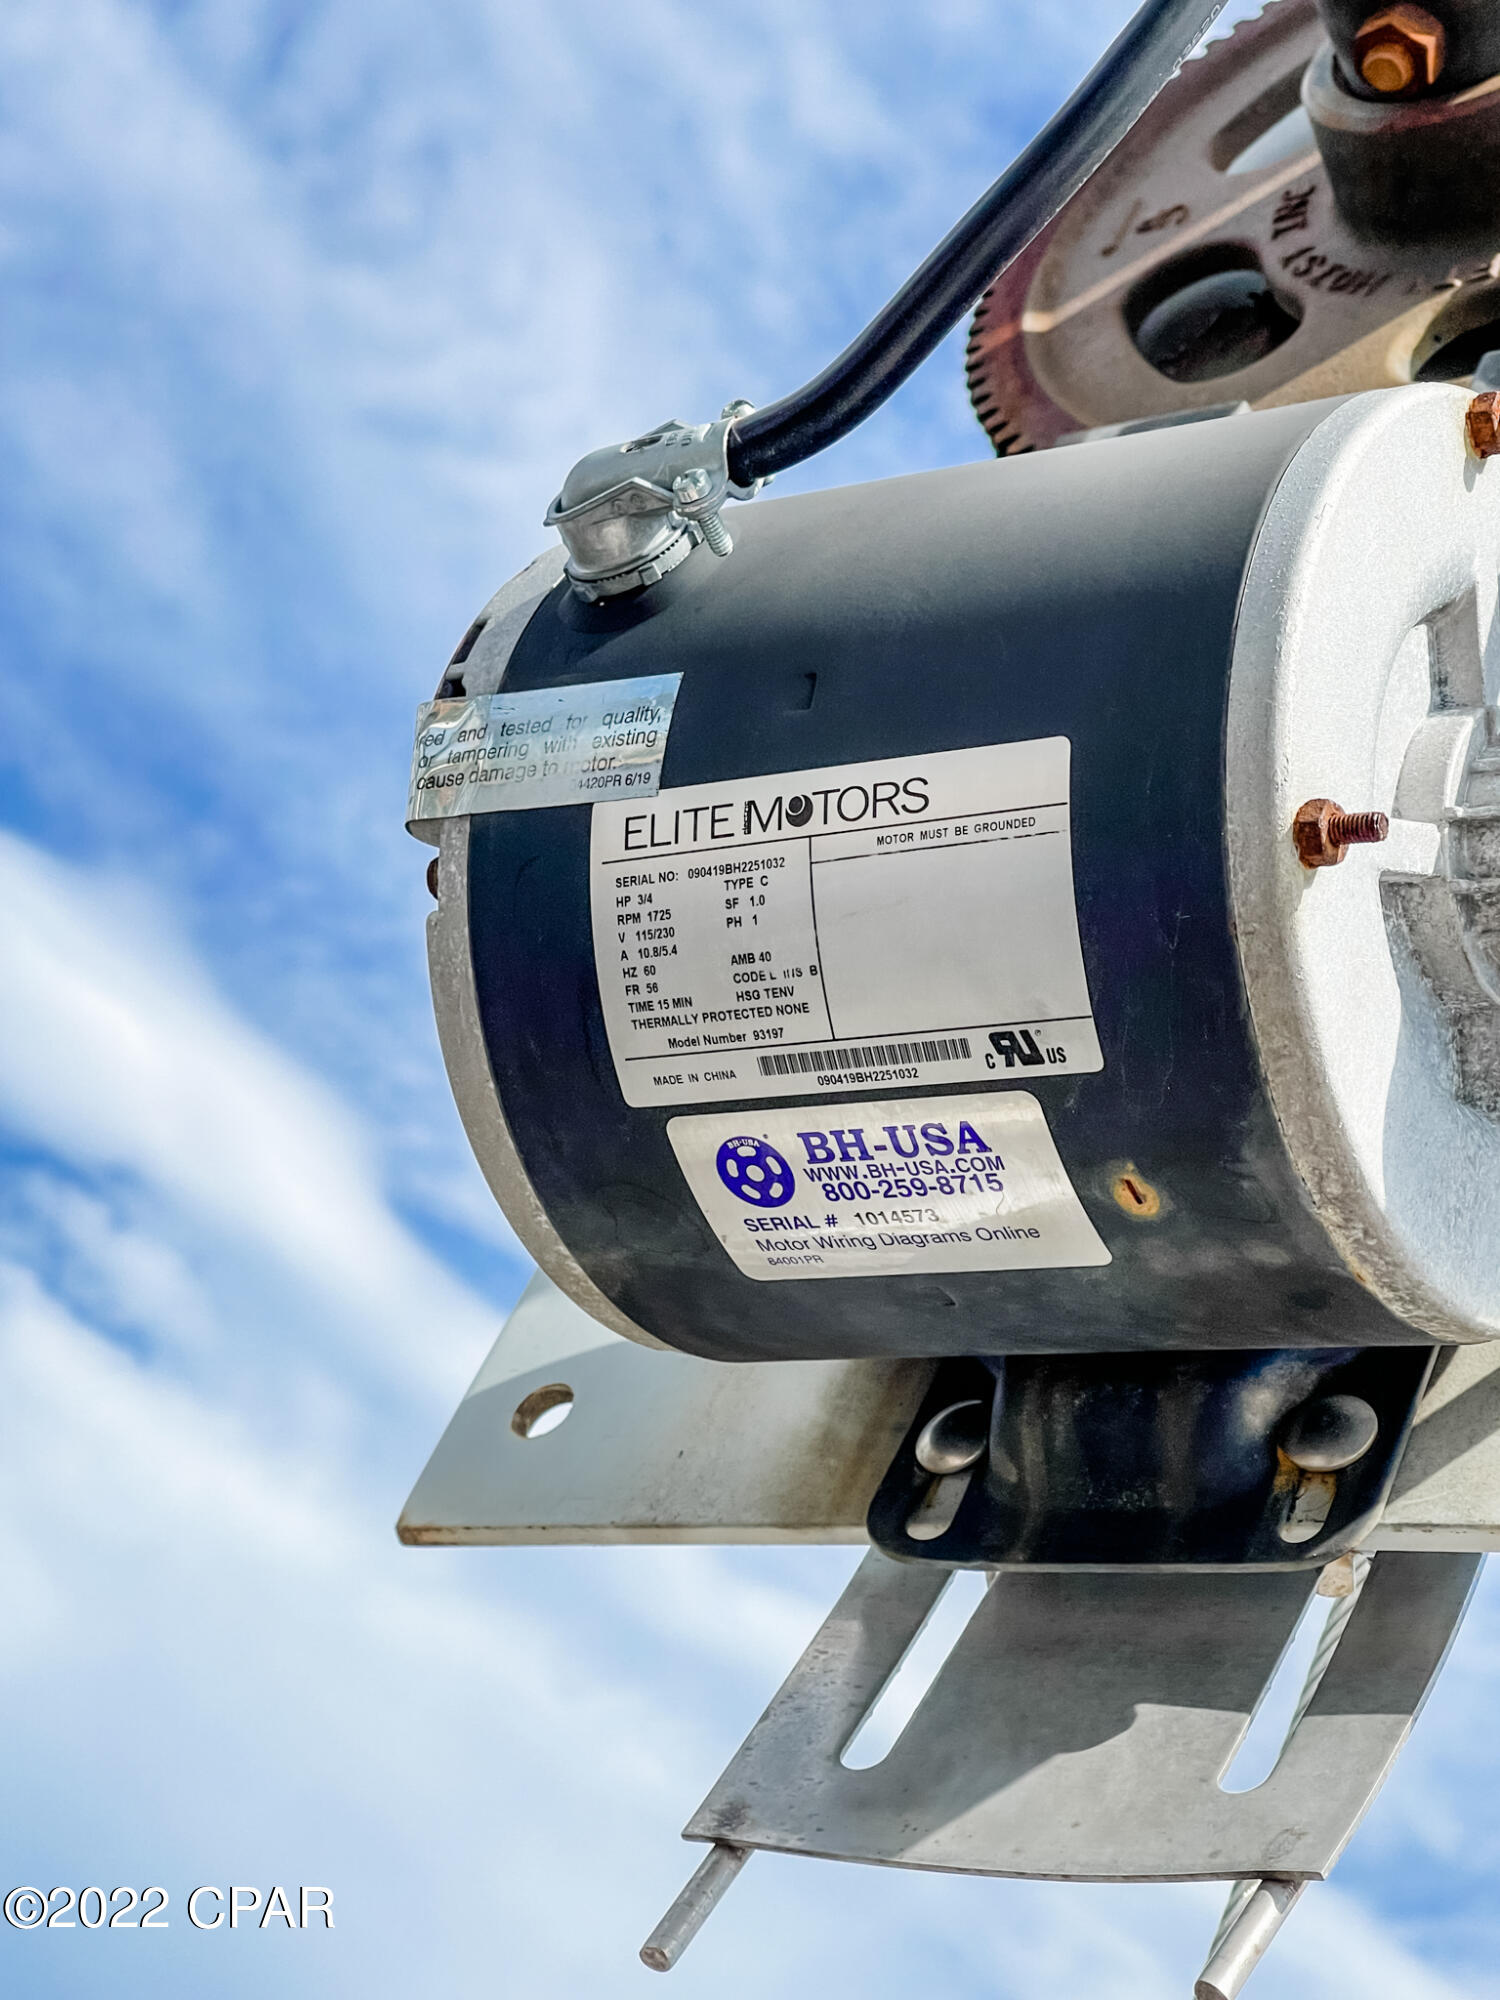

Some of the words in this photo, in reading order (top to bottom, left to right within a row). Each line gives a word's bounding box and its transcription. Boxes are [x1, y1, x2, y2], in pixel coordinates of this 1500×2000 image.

[457, 724, 488, 743] and
[500, 717, 553, 736] tested
[566, 713, 588, 731] for
[602, 705, 662, 727] quality,
[447, 740, 530, 766] tampering
[592, 729, 659, 750] existing
[416, 772, 464, 790] cause
[468, 763, 537, 785] damage
[624, 772, 652, 787] 6/19
[624, 803, 735, 851] ELITE
[876, 832, 915, 846] MOTOR
[920, 828, 949, 841] MUST
[954, 825, 969, 836] BE
[974, 816, 1037, 833] GROUNDED
[615, 876, 655, 888] SERIAL
[658, 870, 679, 883] NO:
[687, 857, 786, 879] 090419BH2251032
[724, 877, 754, 891] TYPE
[760, 875, 769, 887] C
[616, 896, 631, 908] HP
[637, 892, 653, 905] 3/4
[725, 898, 739, 910] SF
[749, 894, 766, 908] 1.0
[617, 912, 641, 926] RPM
[647, 908, 672, 922] 1725
[726, 916, 742, 929] PH
[752, 914, 758, 926] 1
[618, 932, 626, 943] V
[635, 926, 675, 942] 115/230
[620, 949, 629, 961] A
[638, 944, 678, 960] 10.8/5.4
[730, 952, 756, 966] AMB
[758, 950, 772, 963] 40
[622, 966, 638, 979] HZ
[643, 964, 656, 976] 60
[733, 970, 766, 984] CODE
[809, 964, 818, 976] B
[625, 984, 640, 996] FR
[646, 982, 659, 994] 56
[736, 988, 761, 1002] HSG
[764, 985, 795, 999] TENV
[628, 1000, 655, 1013] TIME
[657, 998, 670, 1010] 15
[672, 996, 693, 1009] MIN
[631, 1013, 699, 1031] THERMALLY
[702, 1005, 773, 1024] PROTECTED
[776, 1001, 810, 1016] NONE
[668, 1036, 701, 1049] Model
[703, 1031, 747, 1047] Number
[753, 1027, 784, 1041] 93197
[1046, 1047, 1067, 1063] US
[653, 1073, 684, 1086] MADE
[688, 1073, 699, 1083] IN
[704, 1069, 737, 1082] CHINA
[817, 1068, 920, 1087] 090419BH2251032
[796, 1120, 993, 1164] BH-USA
[803, 1155, 1006, 1183] WWW.BH-USA.COM
[821, 1172, 1004, 1202] 800-259-8715
[743, 1215, 821, 1232] SERIAL
[824, 1214, 838, 1228] #
[854, 1208, 940, 1226] 1014573
[755, 1236, 811, 1252] Motor
[812, 1233, 877, 1250] Wiring
[879, 1230, 972, 1249] Diagrams
[975, 1226, 1041, 1242] Online
